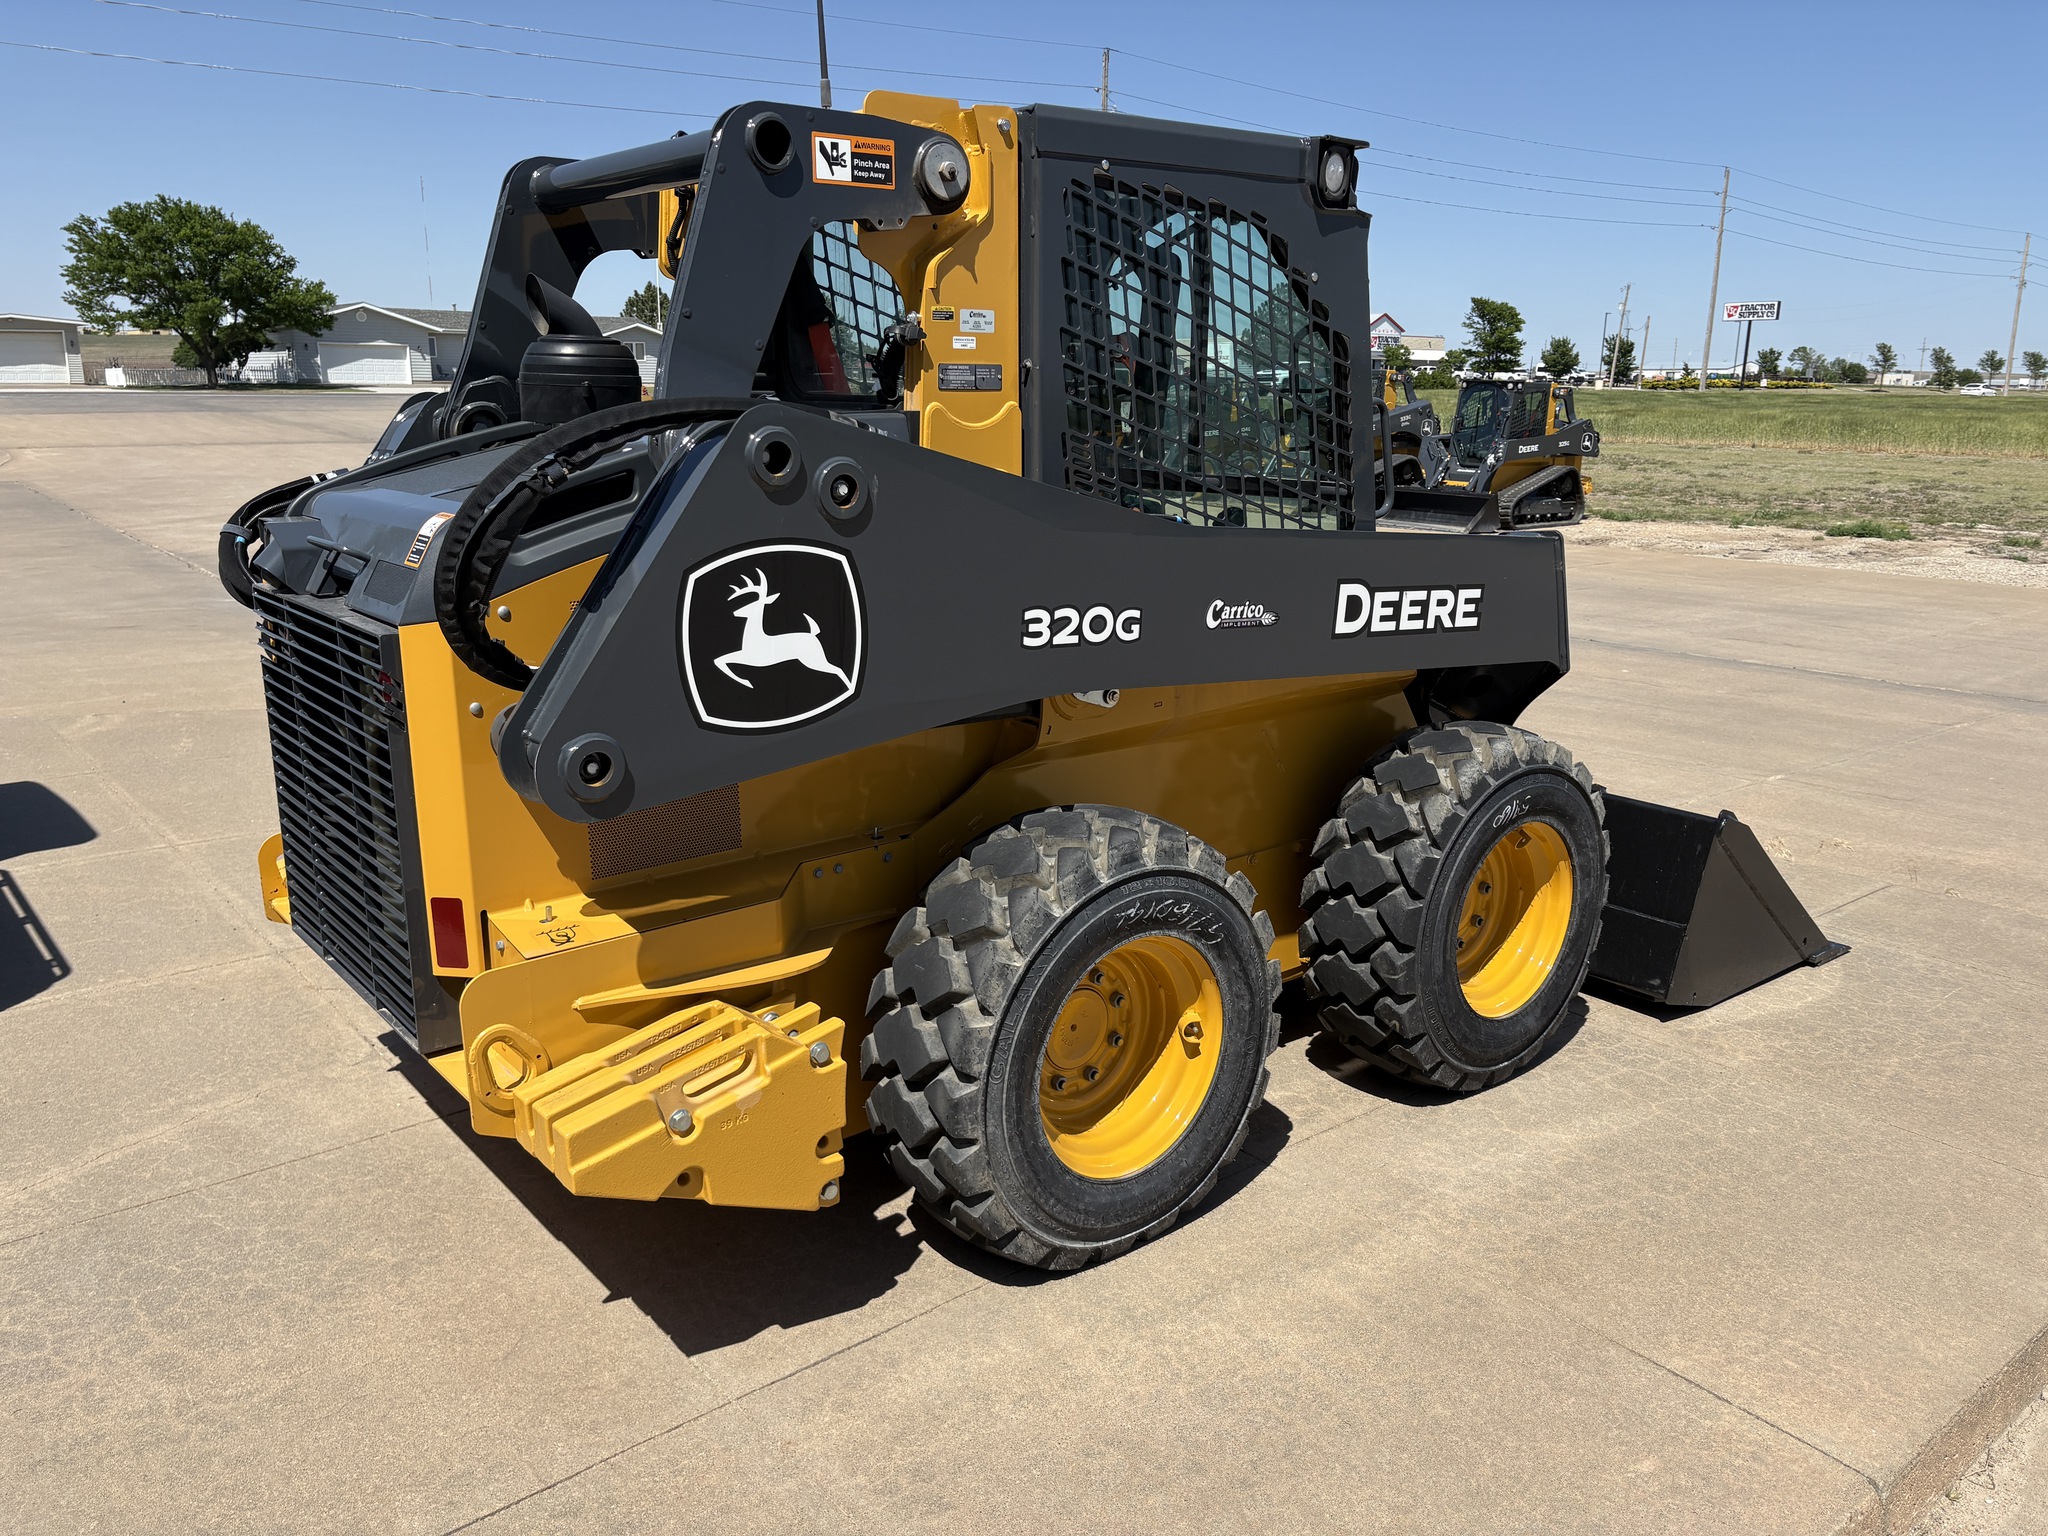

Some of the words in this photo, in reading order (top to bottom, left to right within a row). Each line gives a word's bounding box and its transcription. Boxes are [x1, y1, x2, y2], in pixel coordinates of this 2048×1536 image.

[860, 141, 891, 152] WARNING
[853, 158, 873, 169] Pinch
[874, 159, 890, 170] Area
[853, 169, 870, 179] Keep
[869, 171, 886, 180] Away
[1739, 303, 1776, 312] TRACTOR
[1738, 311, 1766, 319] SUPPLY
[1518, 444, 1539, 454] DEERE
[1206, 599, 1264, 629] Carrico
[1334, 583, 1482, 634] DEERE
[1022, 605, 1141, 647] 320G
[1220, 620, 1260, 628] IMPLEMENT
[988, 943, 1060, 1085] GALAXY
[613, 1048, 632, 1062] USA
[636, 1063, 655, 1077] USA
[658, 1081, 677, 1095] USA
